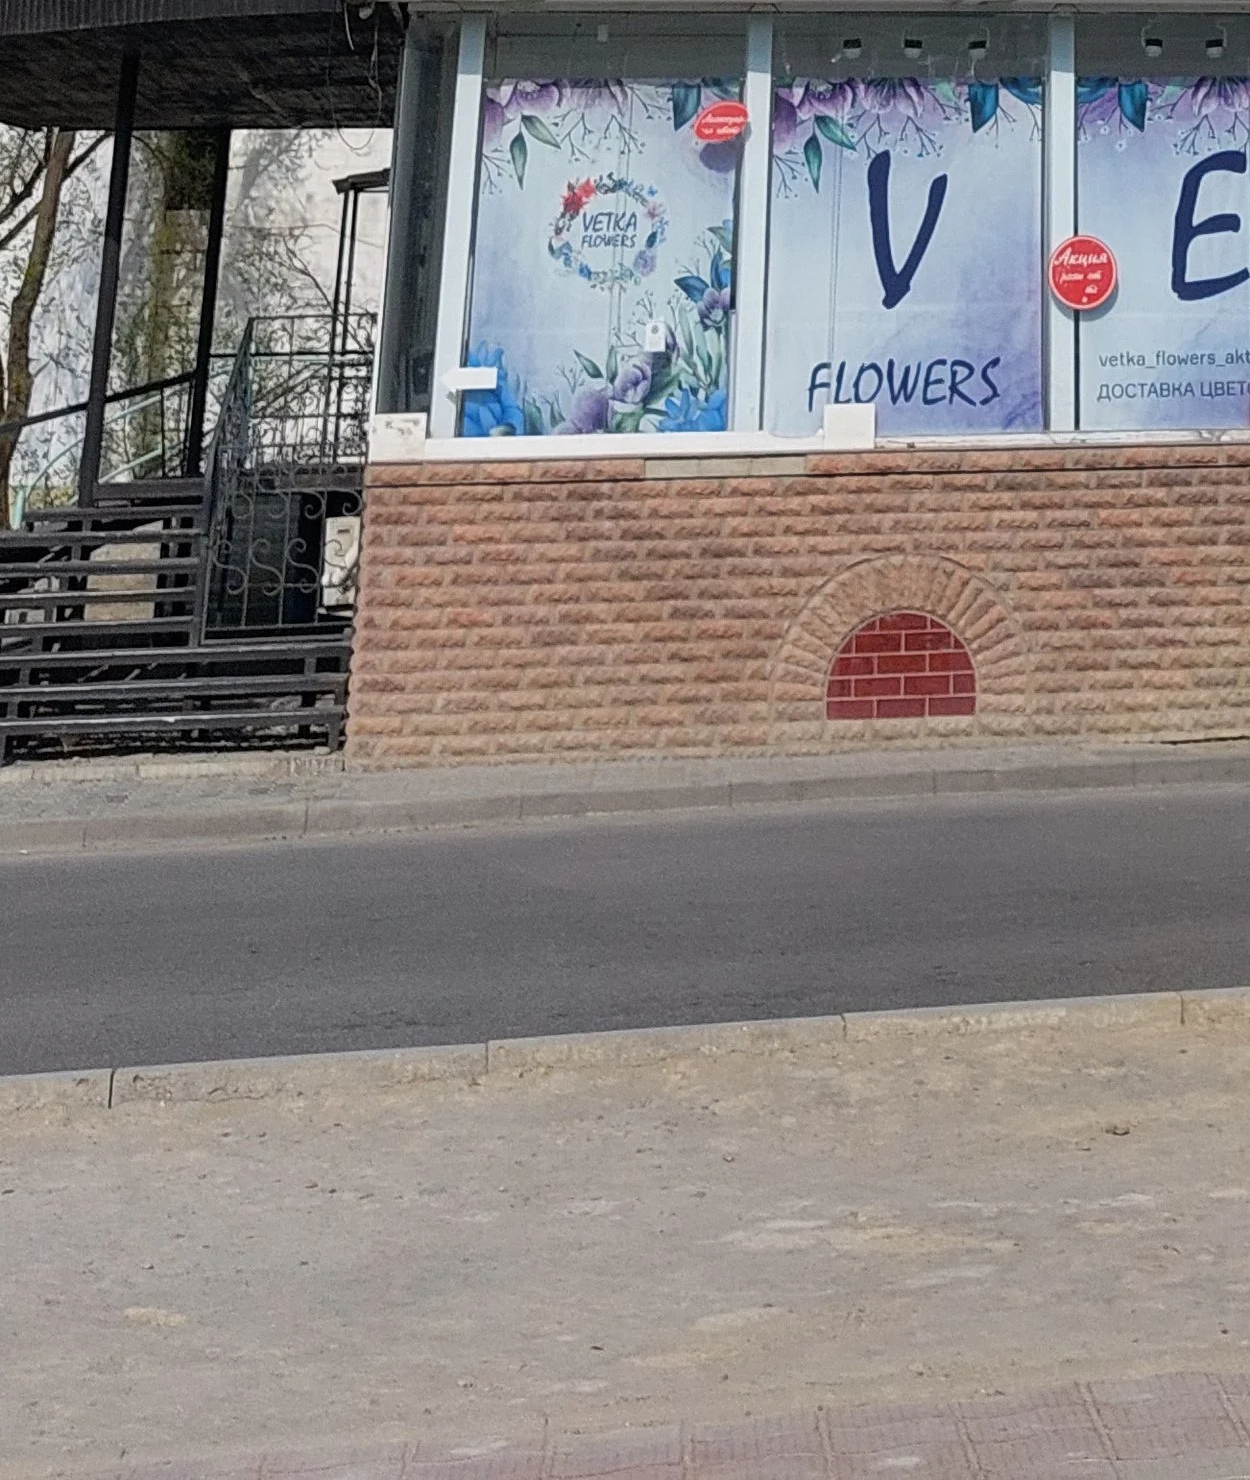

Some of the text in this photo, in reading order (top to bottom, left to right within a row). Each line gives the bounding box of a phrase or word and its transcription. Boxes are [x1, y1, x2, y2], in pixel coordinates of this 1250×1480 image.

[582, 211, 638, 233] VETKA
[581, 233, 637, 249] FLOWERS
[1053, 246, 1108, 268] Акция
[808, 356, 1001, 412] FLOWERS
[1096, 382, 1196, 402] ДОСТАВКА
